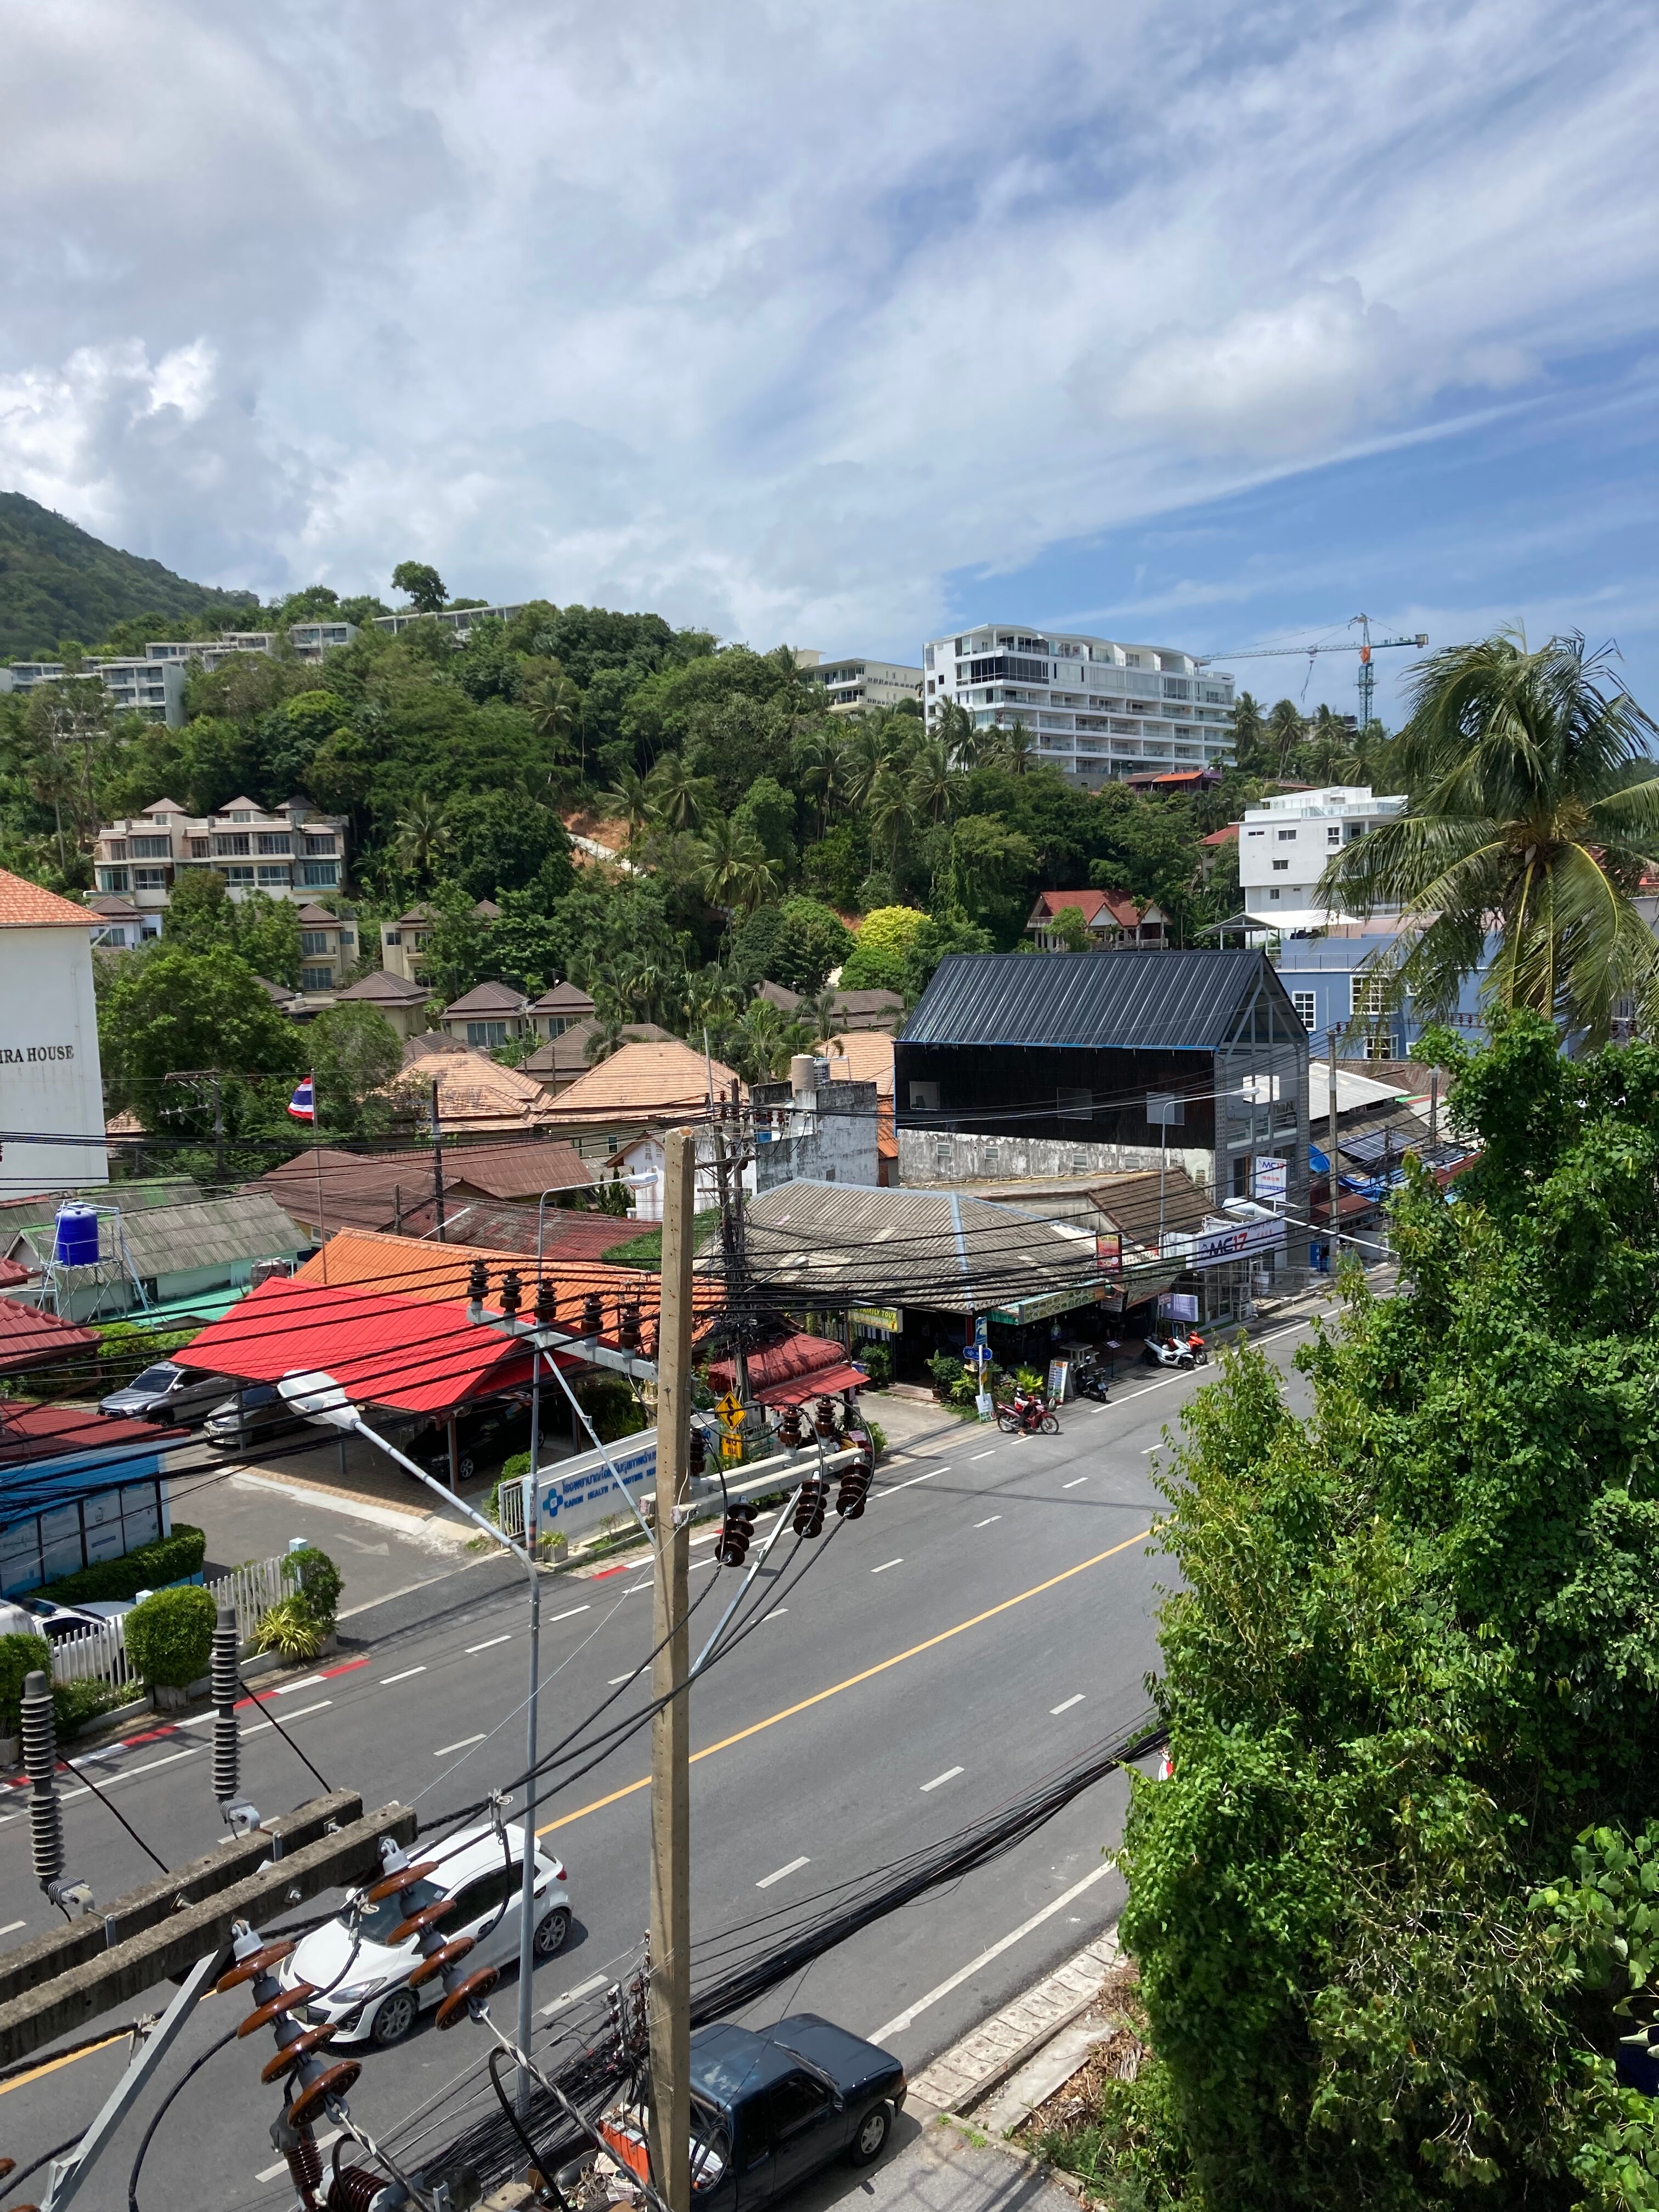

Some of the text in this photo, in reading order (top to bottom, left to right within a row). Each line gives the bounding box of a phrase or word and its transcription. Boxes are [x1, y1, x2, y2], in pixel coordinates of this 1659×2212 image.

[27, 1045, 74, 1062] HOUSE
[1208, 1232, 1248, 1256] MC17
[882, 1311, 896, 1320] TOUR
[564, 1495, 583, 1509] KARON
[588, 1485, 608, 1500] HEALTH
[612, 1472, 643, 1491] PRMOTING
